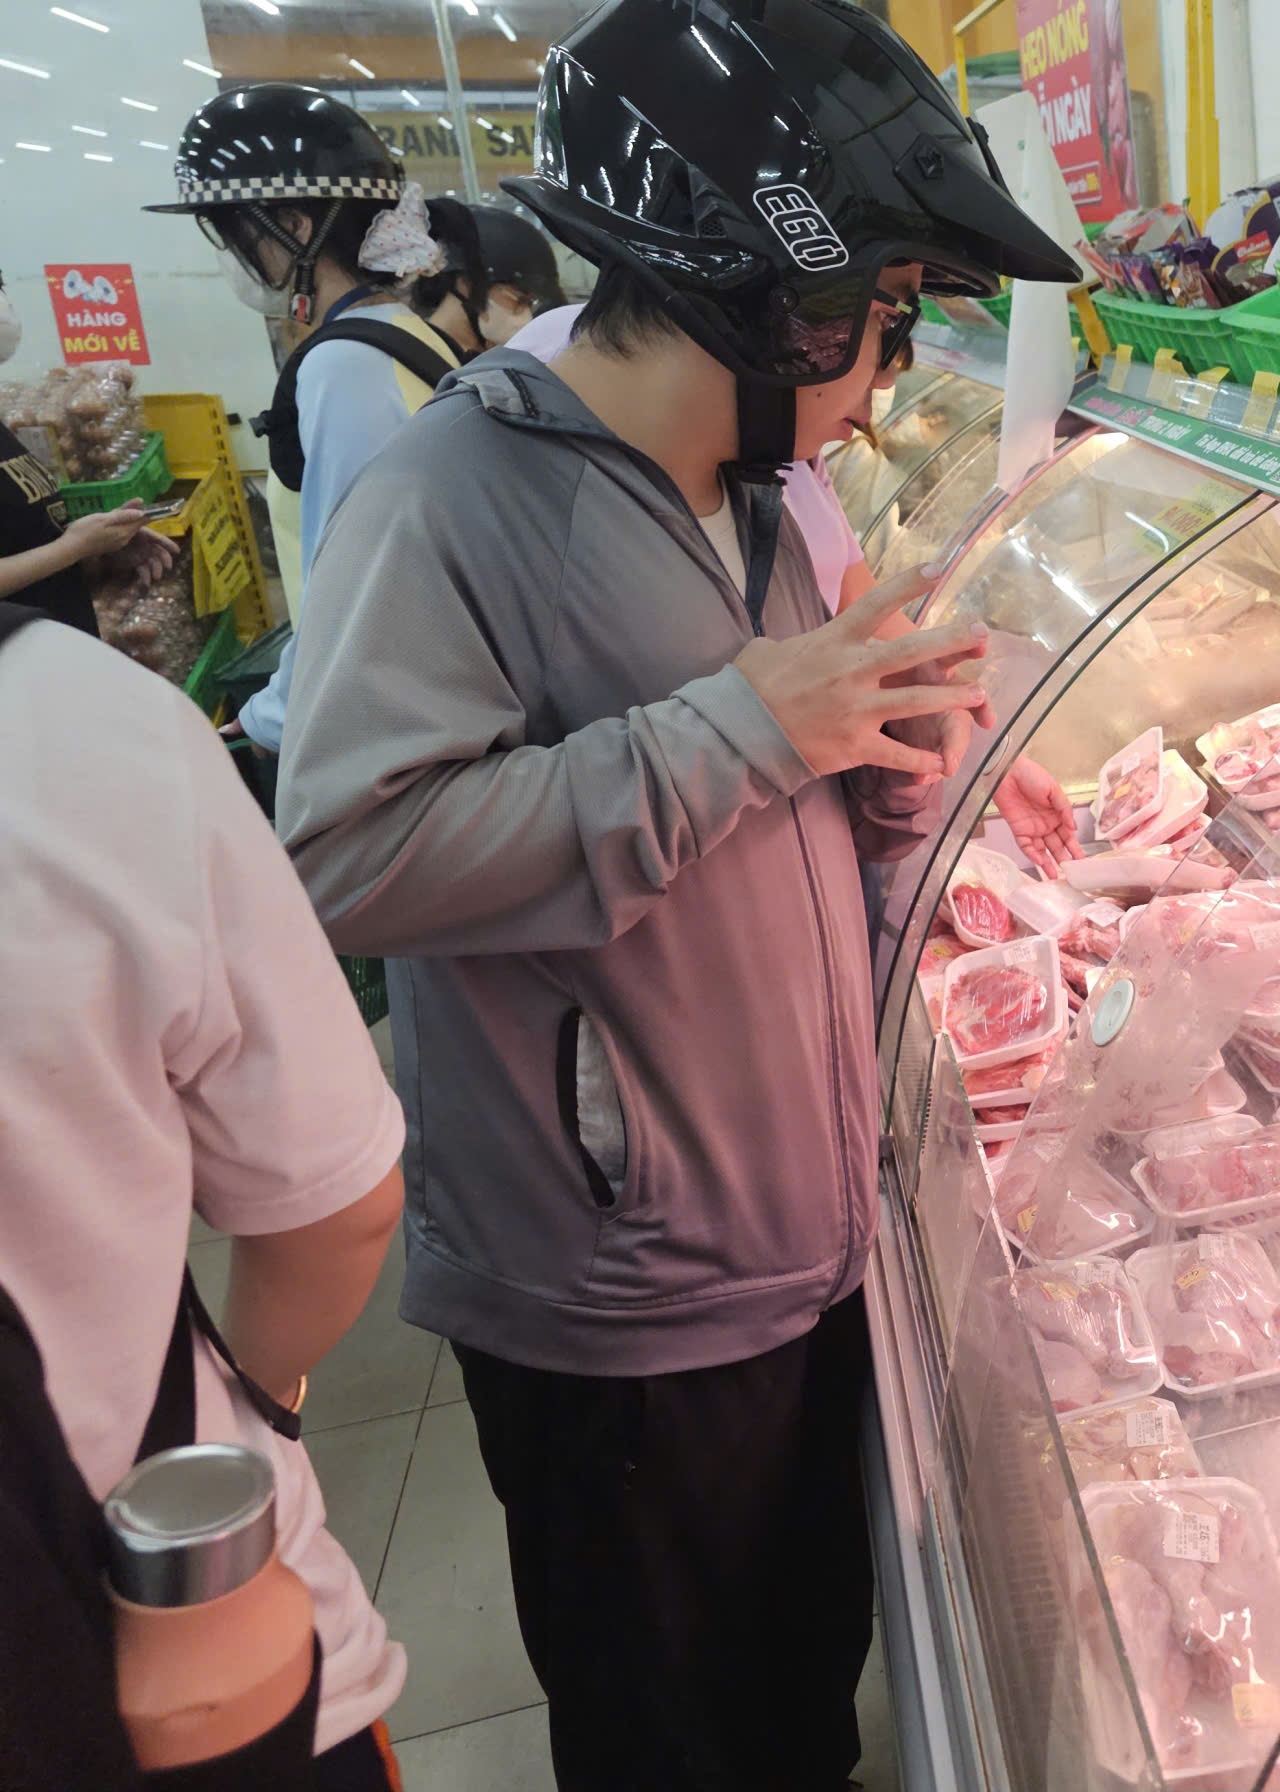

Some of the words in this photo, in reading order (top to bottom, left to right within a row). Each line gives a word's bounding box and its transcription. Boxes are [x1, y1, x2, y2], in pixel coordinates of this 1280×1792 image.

[1021, 25, 1047, 81] HEO
[1056, 75, 1092, 144] NGÀY
[486, 124, 535, 156] SA
[753, 184, 849, 271] EGO
[64, 332, 109, 353] MỚI
[112, 327, 142, 353] VỀ
[66, 308, 128, 328] HÀNG
